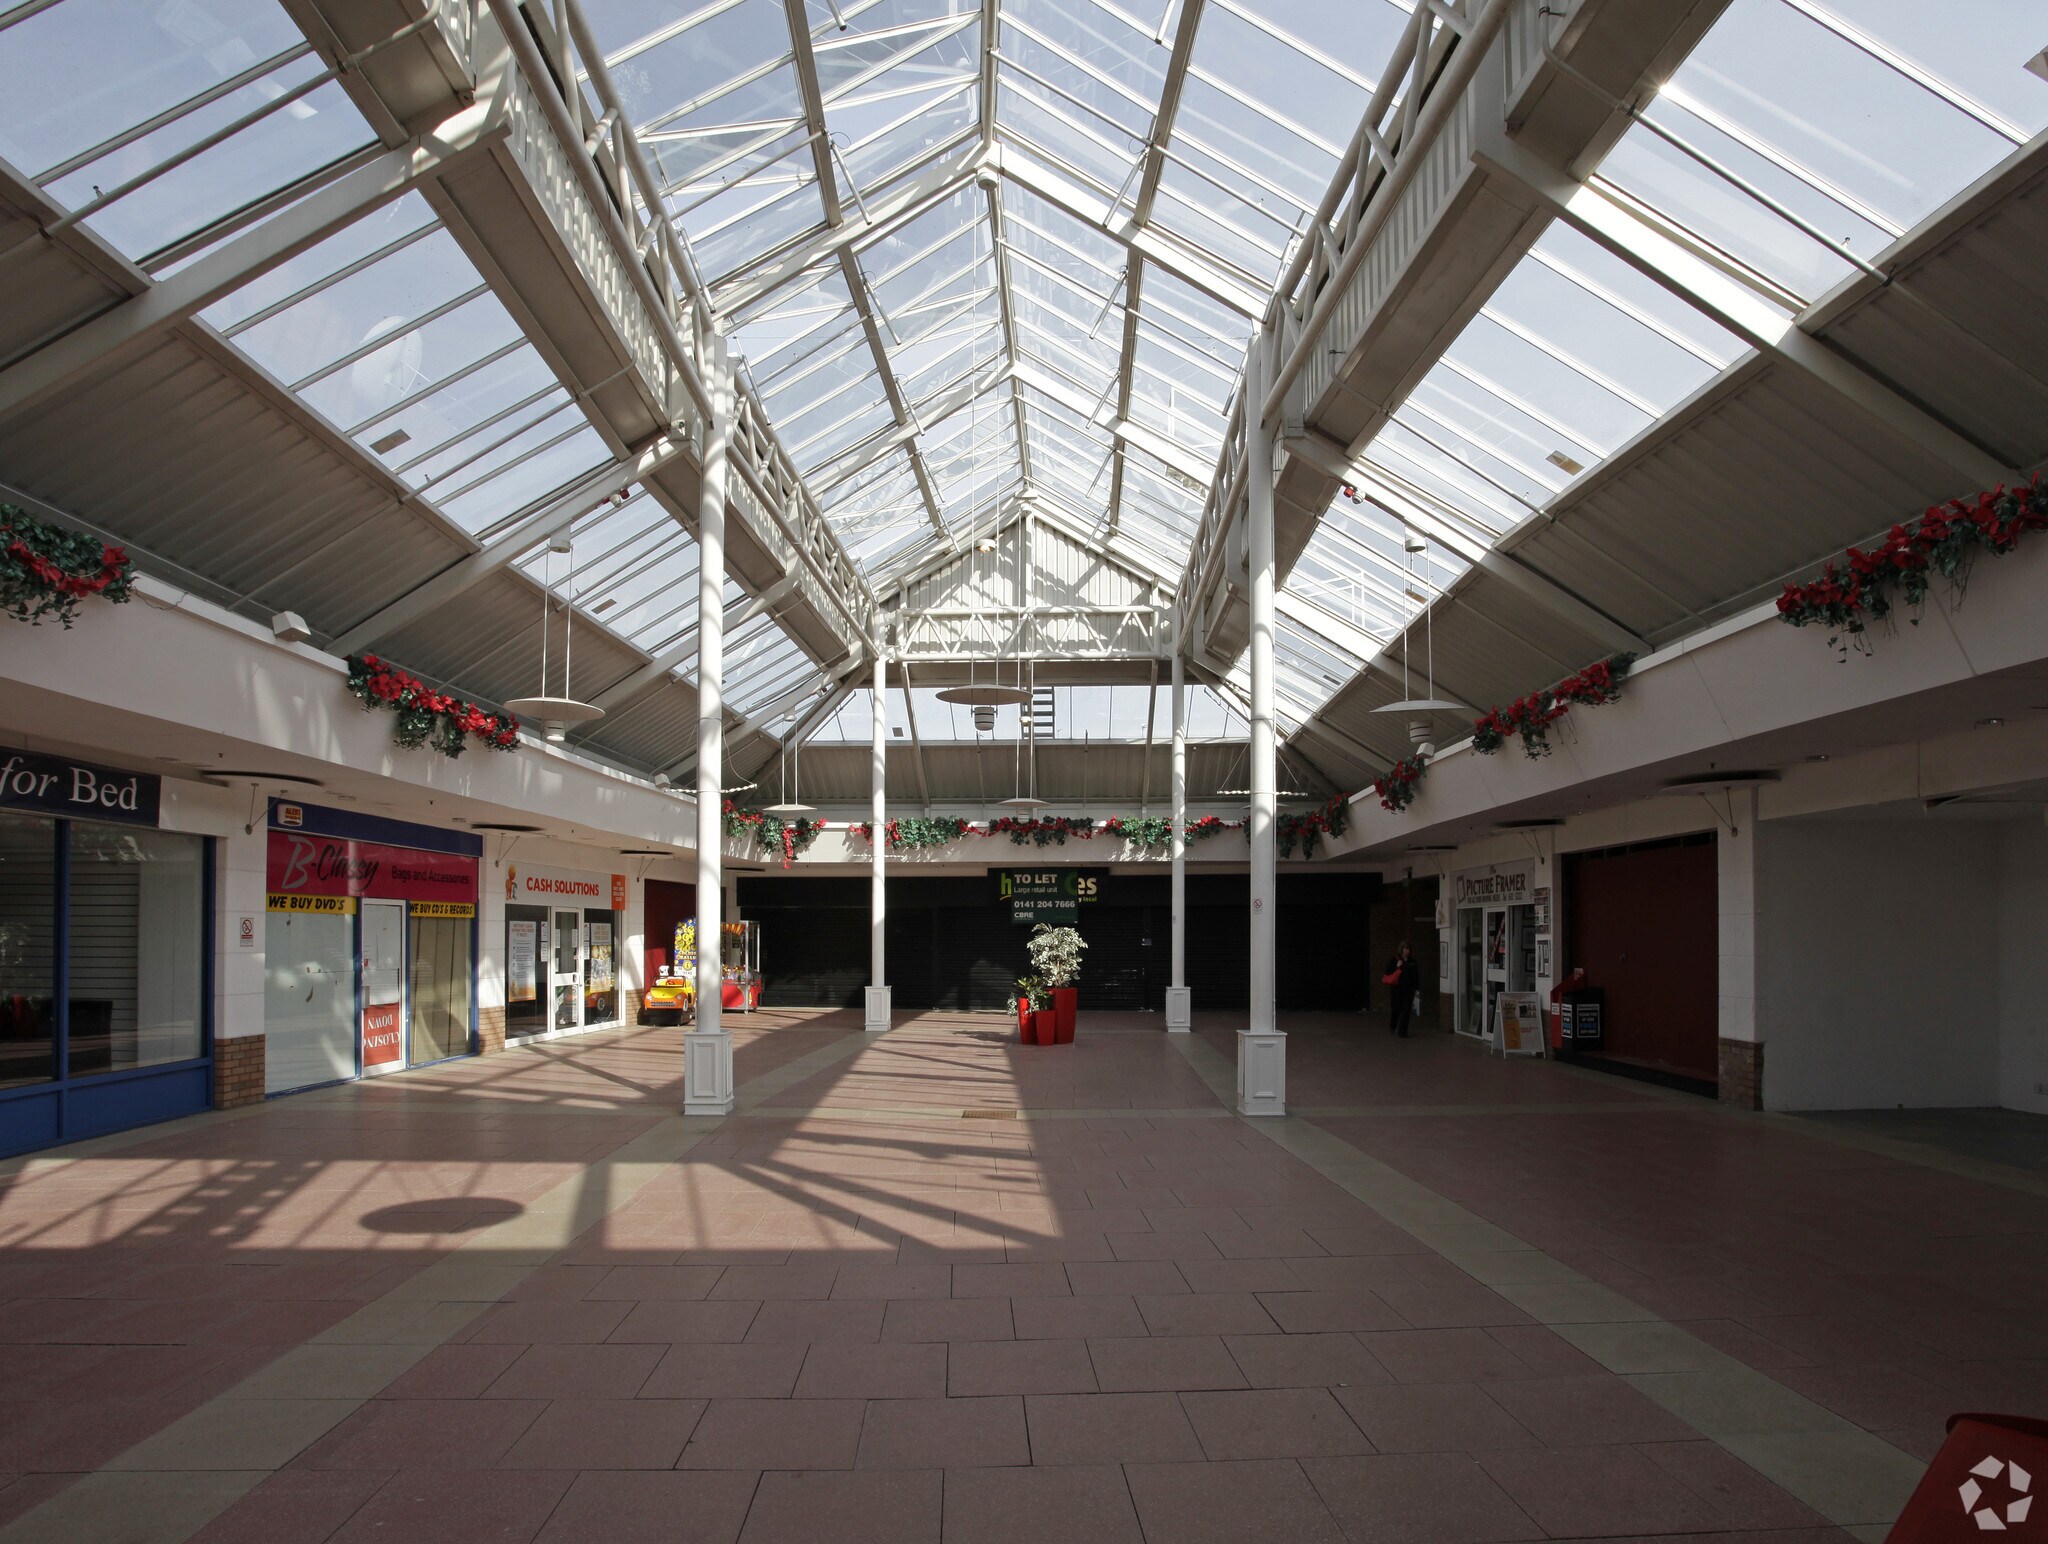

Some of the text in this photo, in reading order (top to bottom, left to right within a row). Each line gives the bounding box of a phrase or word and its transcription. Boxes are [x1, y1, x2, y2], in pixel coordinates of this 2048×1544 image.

[0, 757, 138, 811] for Bed
[391, 866, 469, 884] Bags and Accessories
[1014, 874, 1031, 884] TO
[1035, 874, 1058, 884] LET
[526, 877, 600, 896] CASH SOLUTIONS
[1466, 877, 1494, 896] PICTURE
[1495, 873, 1526, 893] FRAMER
[268, 896, 345, 911] WE BUY DVD'S
[410, 903, 419, 913] WE
[420, 903, 430, 914] BUY
[432, 904, 444, 914] CD'S
[450, 905, 473, 915] RECORDS
[367, 1014, 393, 1030] DOWN
